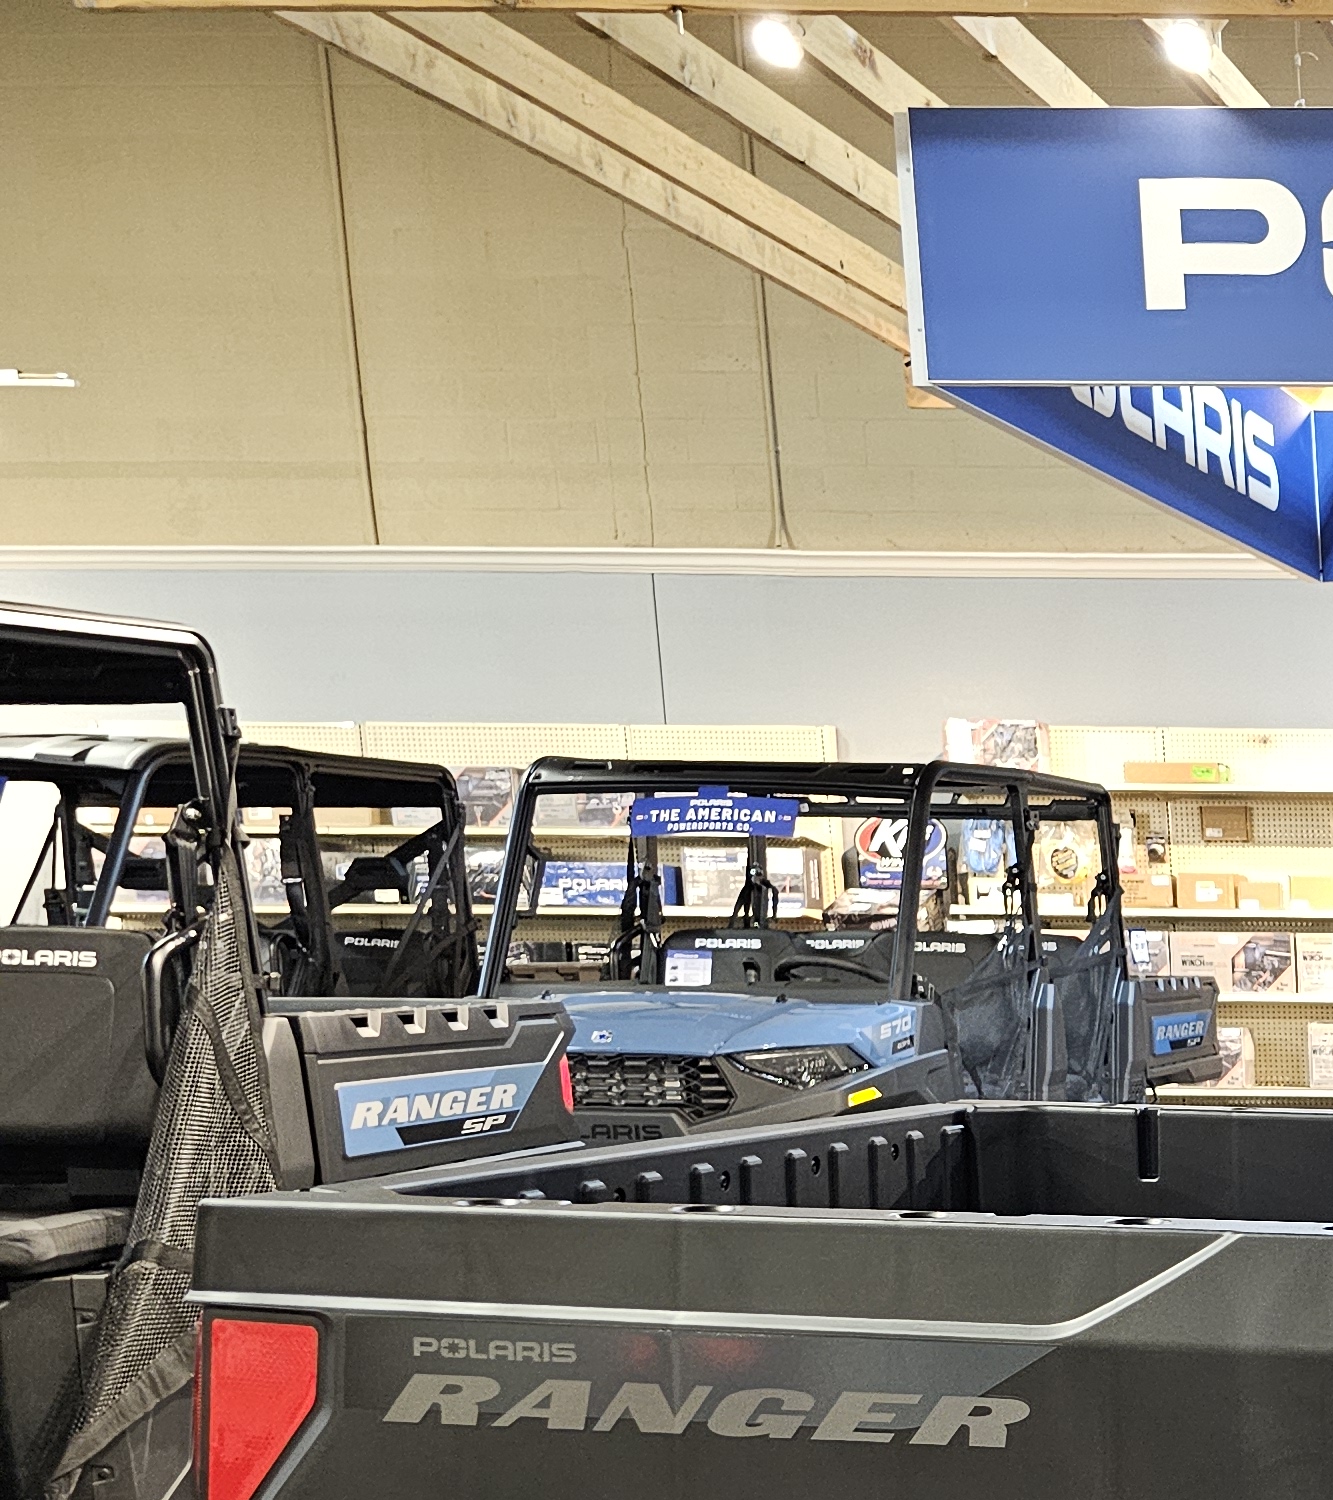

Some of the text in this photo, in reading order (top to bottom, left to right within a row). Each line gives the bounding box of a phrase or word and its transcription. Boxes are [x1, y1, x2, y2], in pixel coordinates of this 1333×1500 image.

[650, 808, 776, 823] THE AMERICAN
[667, 822, 734, 832] POWERSPORTS
[695, 937, 762, 950] POLARIS
[0, 949, 98, 968] OLARIS
[879, 1008, 912, 1041] 570
[1156, 1021, 1204, 1041] RANGER
[350, 1083, 518, 1130] RANGER
[461, 1114, 507, 1135] SP
[412, 1335, 577, 1363] POLARIS
[383, 1372, 1031, 1448] RANGER
